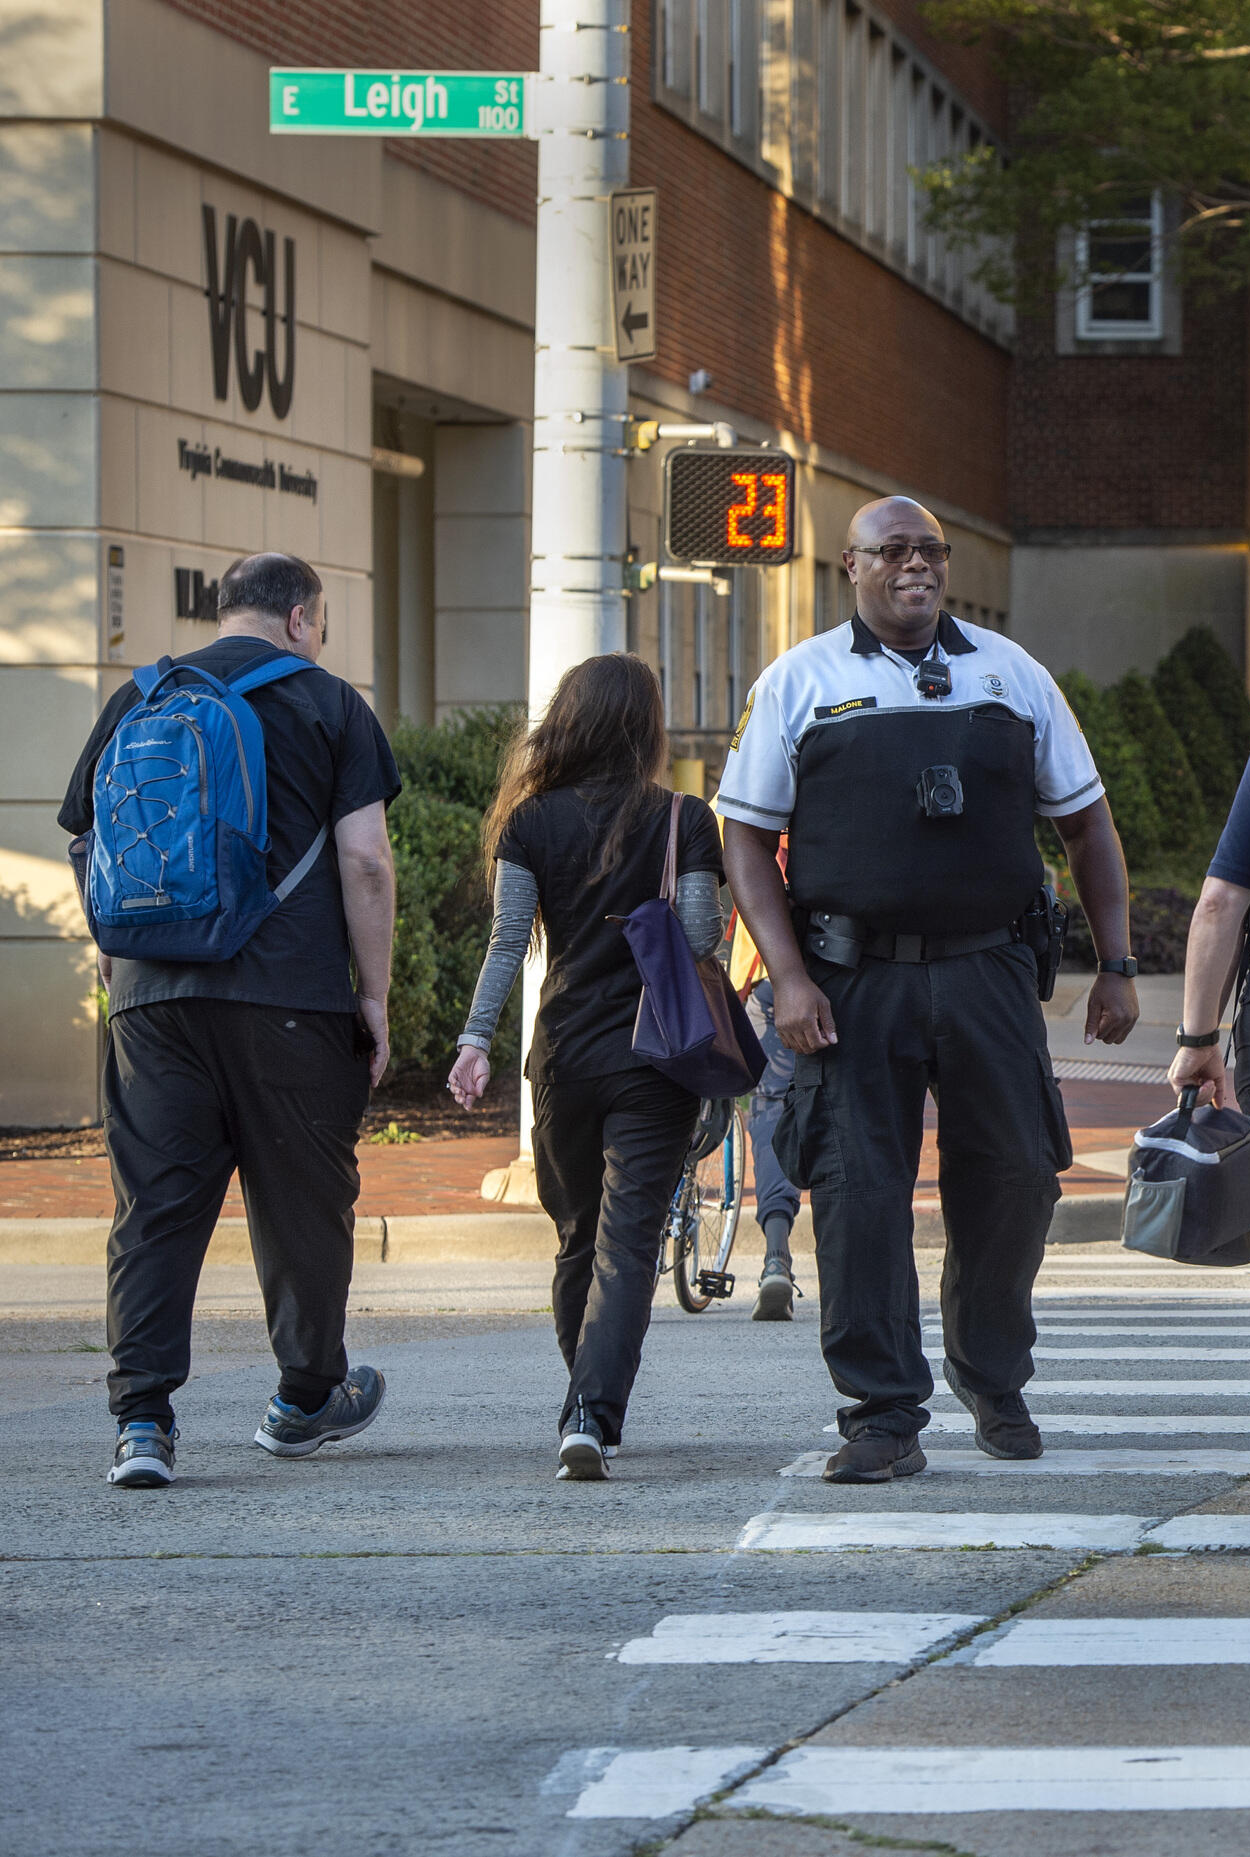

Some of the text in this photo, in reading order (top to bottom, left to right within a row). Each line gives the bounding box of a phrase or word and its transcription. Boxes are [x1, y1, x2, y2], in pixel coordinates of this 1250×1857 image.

[282, 74, 519, 131] E Leigh St
[478, 106, 519, 130] 1100
[616, 205, 650, 245] ONE
[616, 252, 650, 291] WAY
[202, 203, 295, 420] VCU
[727, 473, 787, 547] 23
[830, 700, 863, 714] MALONE
